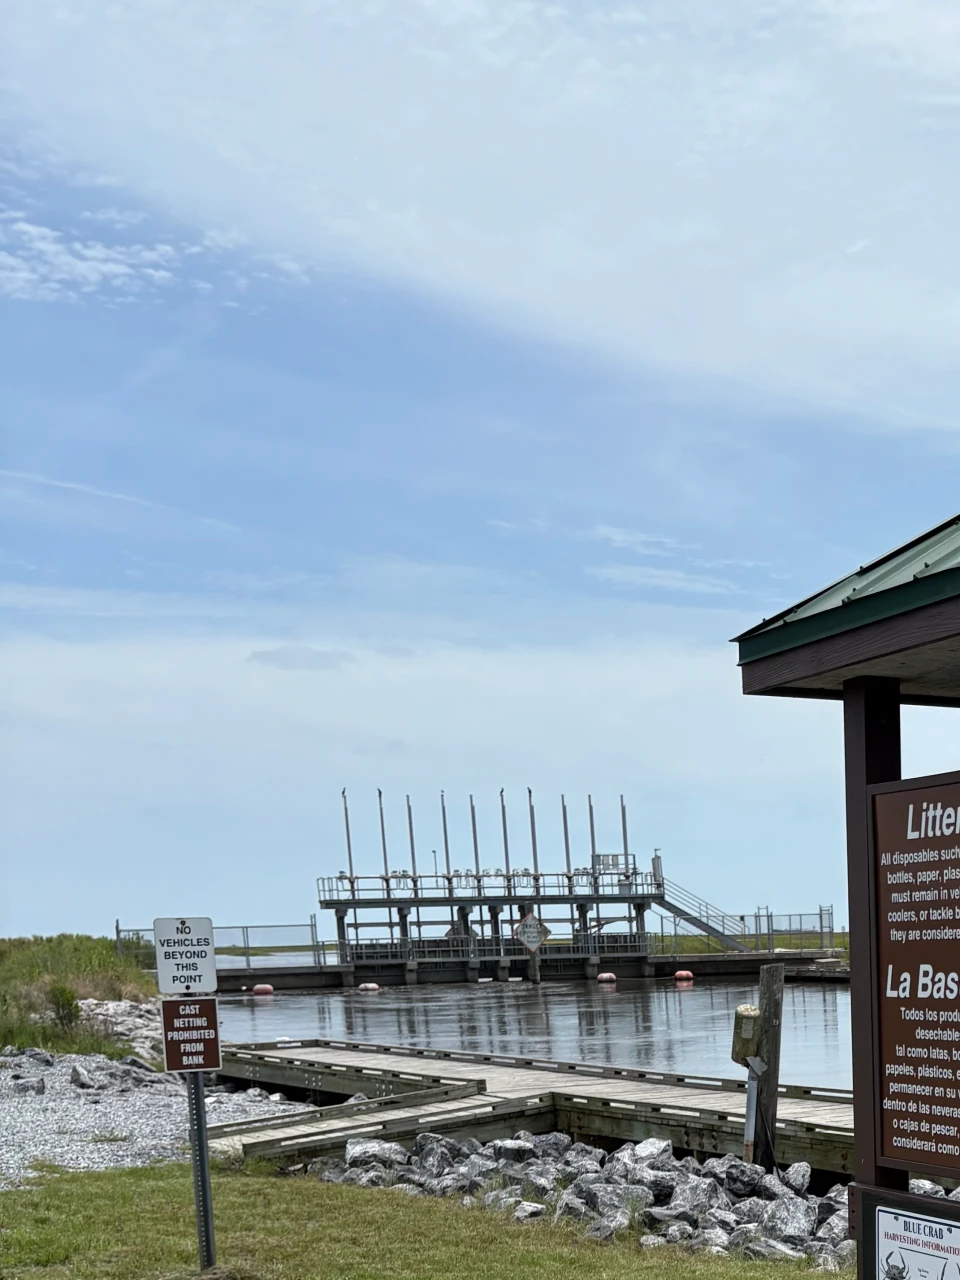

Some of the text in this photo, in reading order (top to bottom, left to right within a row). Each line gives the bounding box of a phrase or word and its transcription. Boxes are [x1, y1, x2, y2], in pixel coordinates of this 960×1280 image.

[881, 852, 891, 866] All
[892, 849, 939, 867] disposables
[941, 846, 960, 861] such
[887, 871, 915, 885] bottles,
[917, 869, 942, 885] paper,
[891, 890, 910, 903] must
[912, 888, 939, 902] remain
[940, 887, 948, 900] in
[888, 909, 918, 923] coolers,
[919, 910, 928, 921] or
[929, 906, 954, 920] tackle
[176, 926, 191, 935] NO
[890, 928, 906, 943] they
[908, 929, 920, 940] are
[159, 938, 210, 948] VEHICLES
[164, 950, 207, 960] BEYOND
[174, 963, 198, 971] THIS
[172, 975, 203, 984] POINT
[886, 964, 911, 998] La
[179, 1005, 200, 1015] CAST
[900, 1007, 924, 1021] Todos
[926, 1008, 938, 1021] los
[174, 1017, 208, 1028] NETTING
[168, 1029, 215, 1041] PROHIBITED
[180, 1042, 204, 1053] FROM
[896, 1044, 905, 1057] tal
[906, 1046, 928, 1059] como
[929, 1046, 951, 1062] latas,
[182, 1055, 204, 1066] BANK
[886, 1063, 916, 1078] papeles,
[917, 1064, 955, 1081] plásticos,
[889, 1082, 933, 1096] permanecer
[934, 1085, 945, 1097] en
[946, 1088, 956, 1099] su
[883, 1097, 907, 1111] dentro
[907, 1099, 918, 1113] de
[919, 1101, 930, 1114] las
[892, 1118, 898, 1128] o
[899, 1118, 919, 1133] cajas
[920, 1119, 930, 1133] de
[931, 1123, 960, 1139] pescar,
[892, 1136, 936, 1152] considerará
[938, 1142, 960, 1156] como
[904, 1220, 944, 1240] BLUE CRAB
[884, 1232, 921, 1247] HARVESTING
